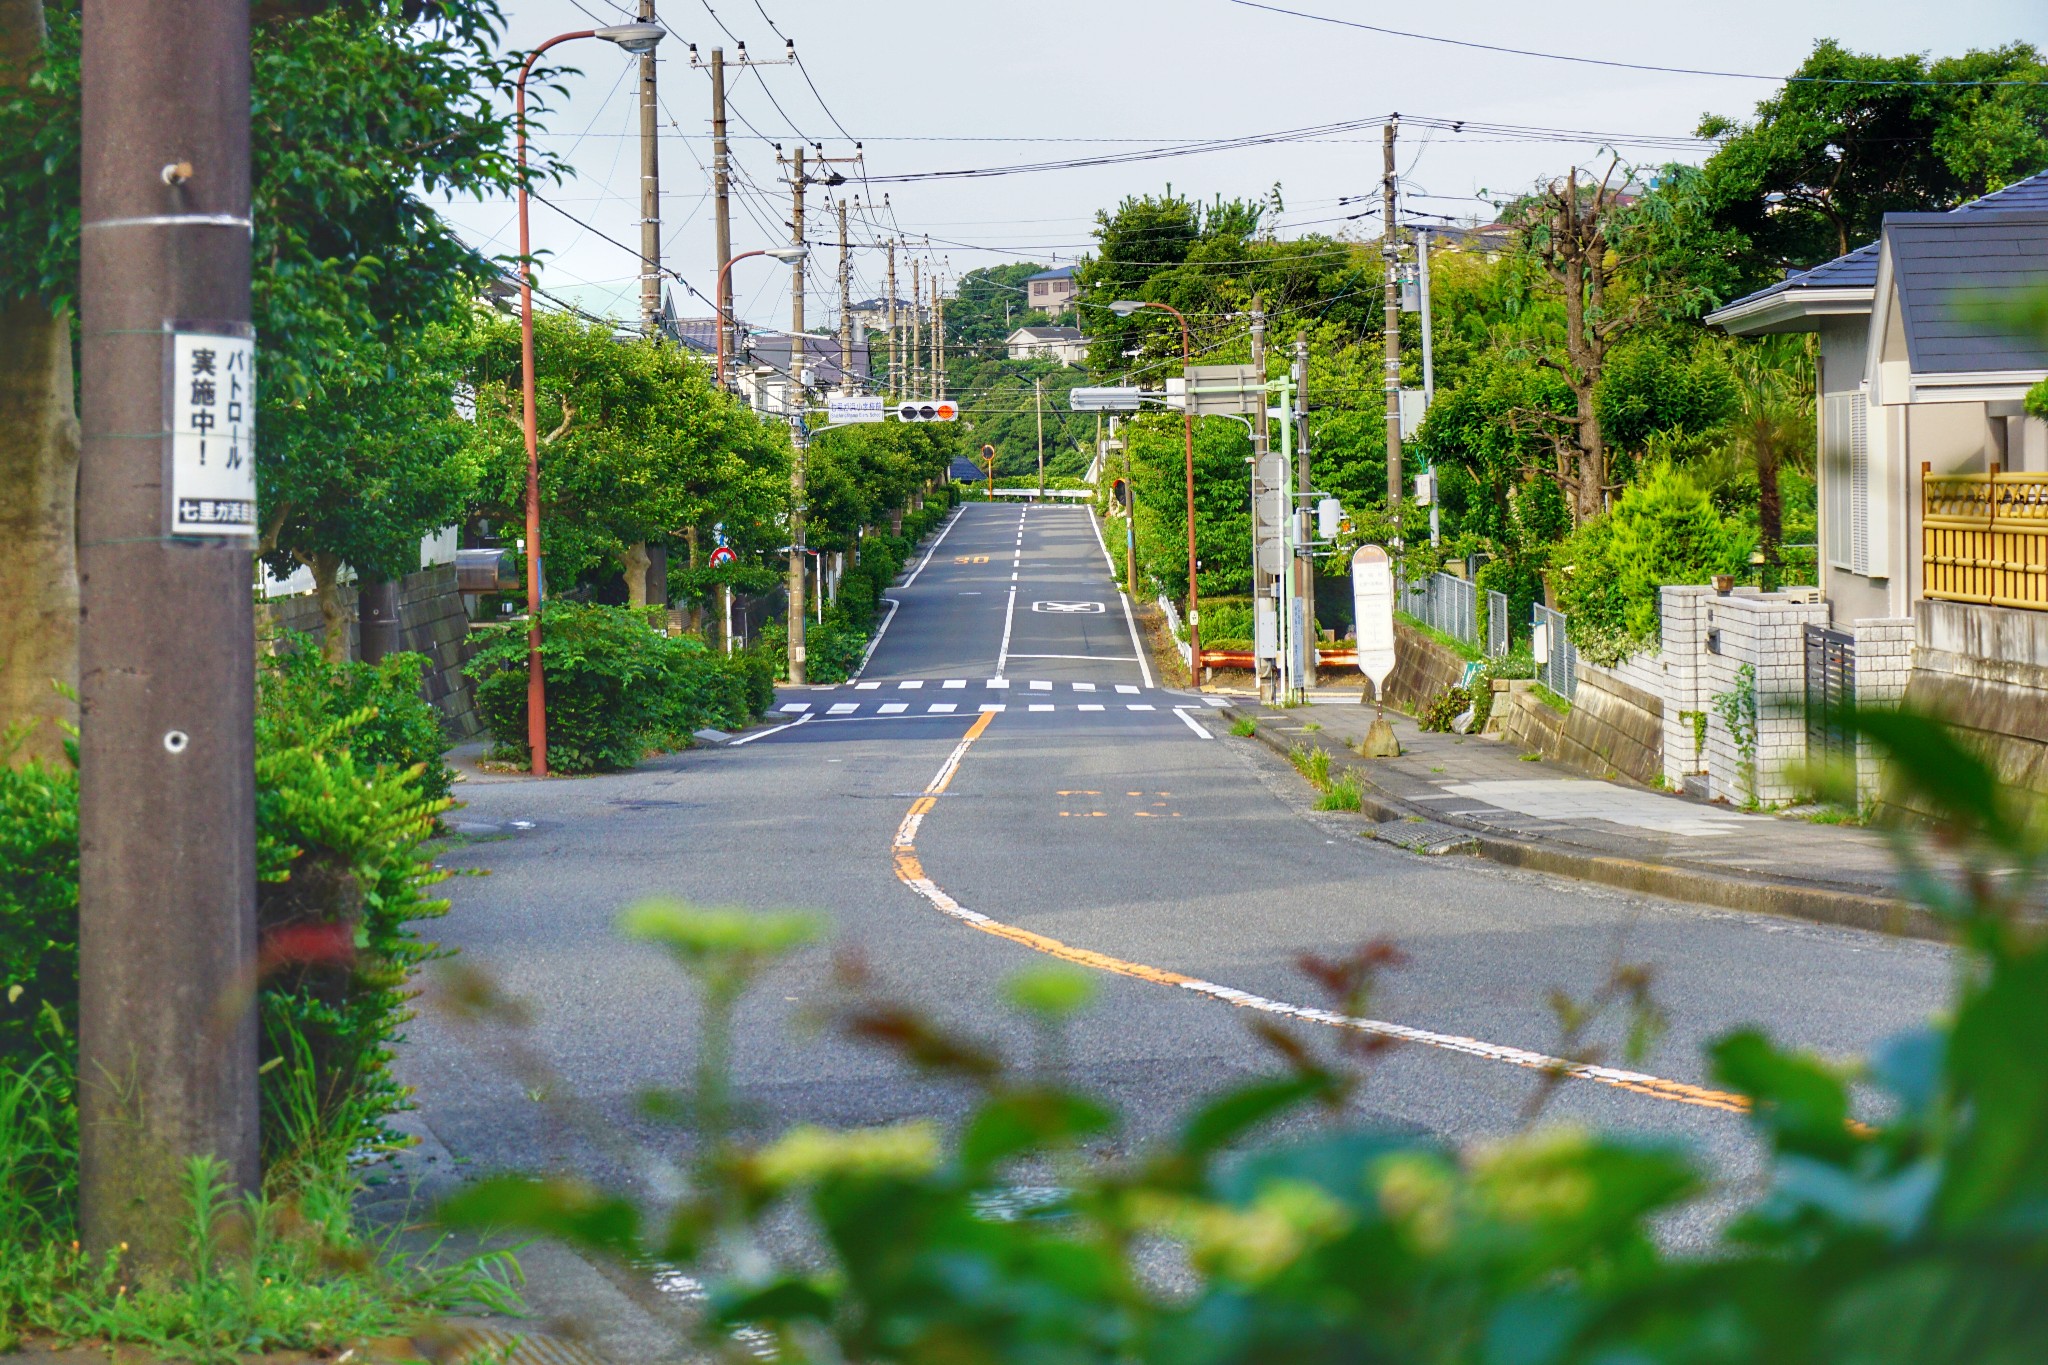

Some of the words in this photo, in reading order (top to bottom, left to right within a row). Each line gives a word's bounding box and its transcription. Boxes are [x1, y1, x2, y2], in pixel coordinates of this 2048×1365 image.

[190, 348, 216, 466] 実施中！
[226, 350, 244, 470] パトロール
[954, 556, 989, 564] 30
